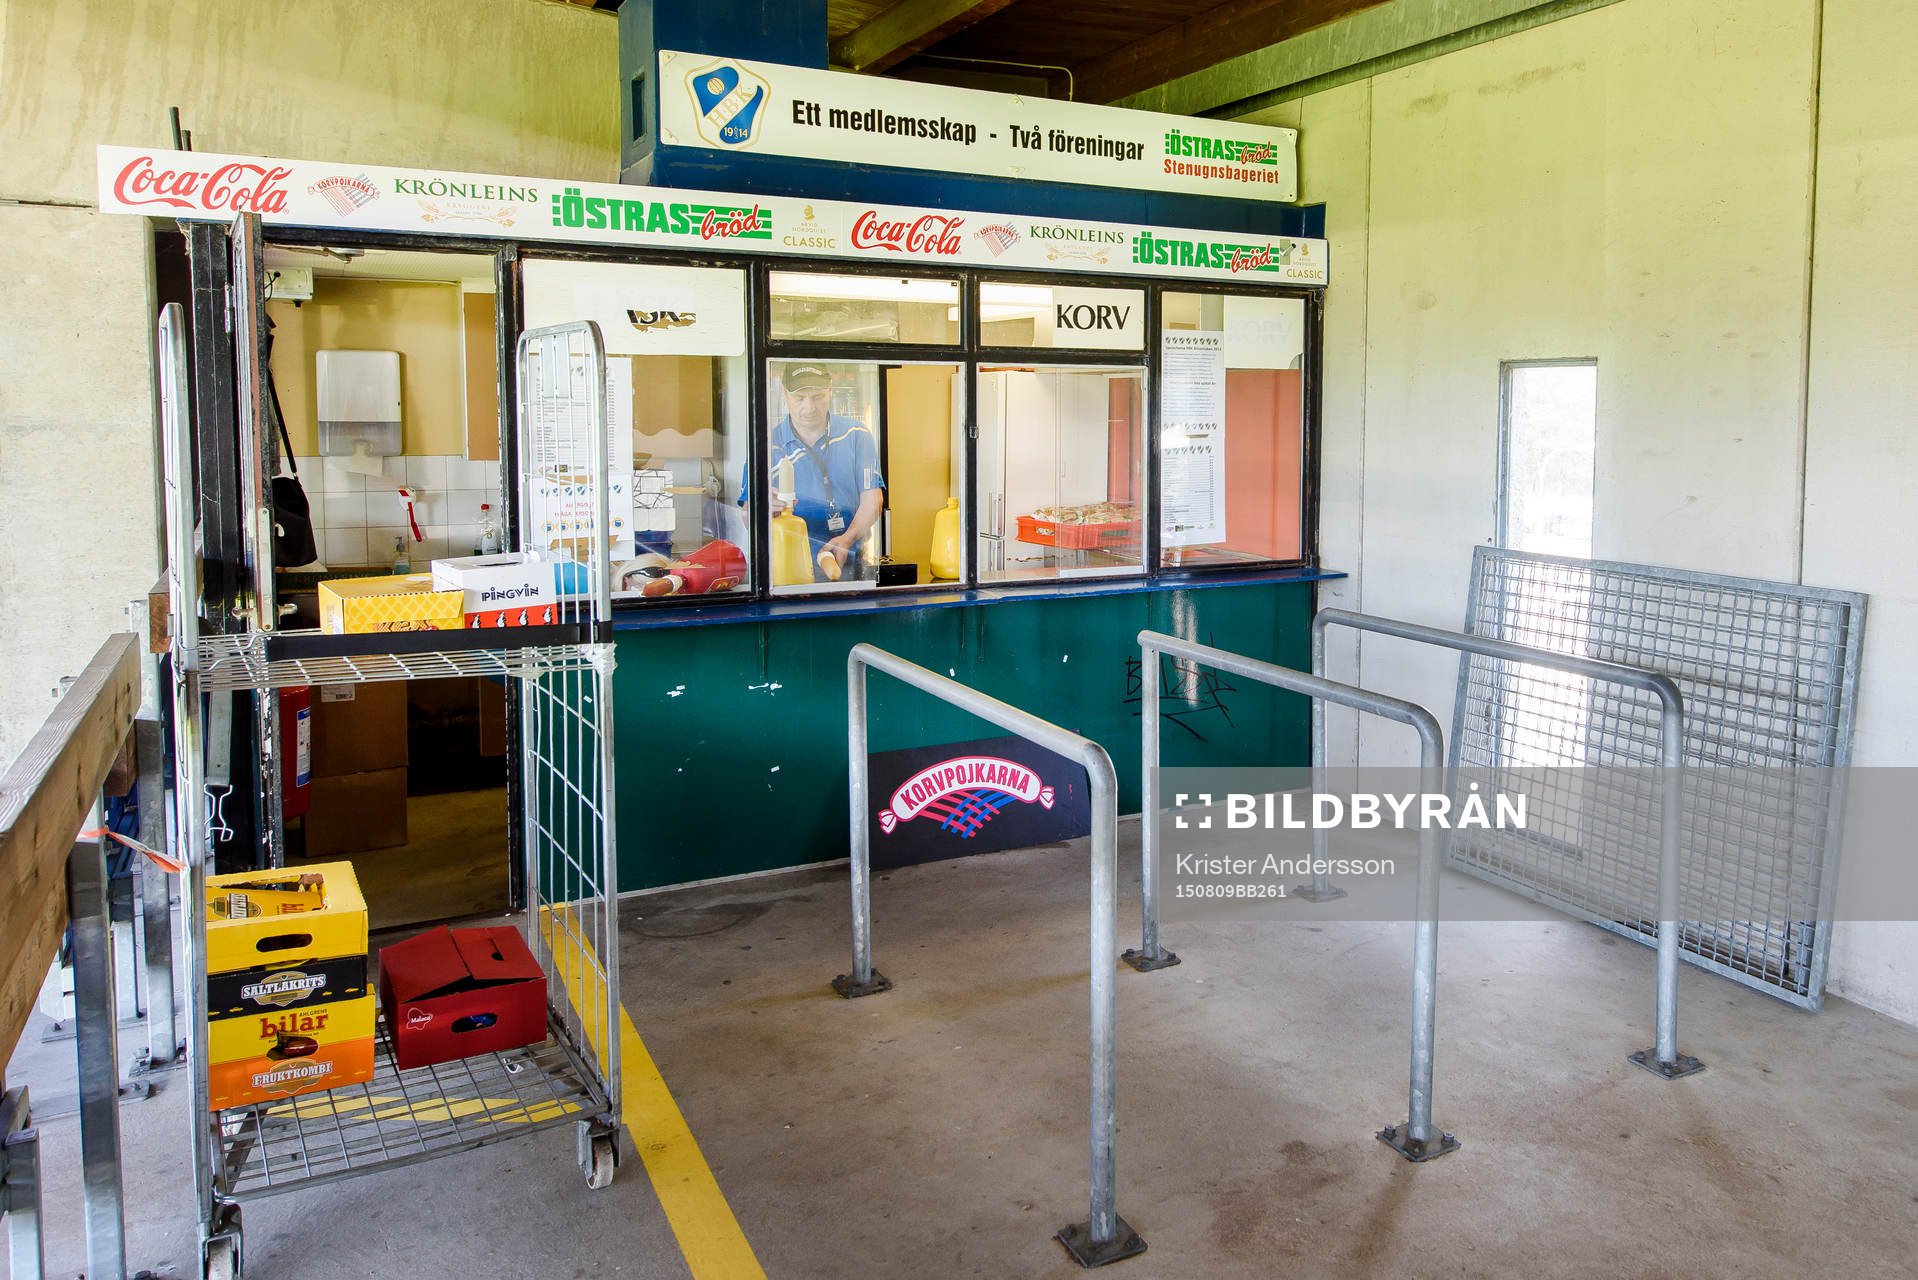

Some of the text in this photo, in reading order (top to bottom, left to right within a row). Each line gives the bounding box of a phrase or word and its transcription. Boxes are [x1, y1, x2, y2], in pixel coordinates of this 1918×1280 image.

[792, 99, 822, 127] Ett
[829, 108, 977, 146] medlemsskap
[1009, 124, 1042, 150] Två
[1048, 129, 1145, 162] föreningar
[1170, 128, 1272, 165] ÖSTRAS bröd
[1163, 158, 1279, 184] Stenugnsbageriet
[113, 156, 293, 214] Coca-Cola
[316, 178, 370, 193] KORVPOJKARNA
[394, 178, 538, 203] KRÖNLEINS
[562, 187, 761, 240] ÖSTRAS bröd
[783, 235, 838, 249] CLASSIC
[851, 210, 966, 255] Coca-Cola
[1030, 224, 1125, 245] KRÖNLEINS
[1139, 231, 1273, 274] ÖSTRAS bröd
[1286, 268, 1324, 280] CLASSIC
[1056, 303, 1131, 330] KORV
[900, 763, 1031, 812] KORVPOJKARNA
[243, 975, 325, 998] SALTLAKRITS
[299, 1008, 328, 1017] AHLGRENS
[260, 1013, 329, 1039] bilar
[254, 1063, 333, 1086] FRUKTKOMBI
